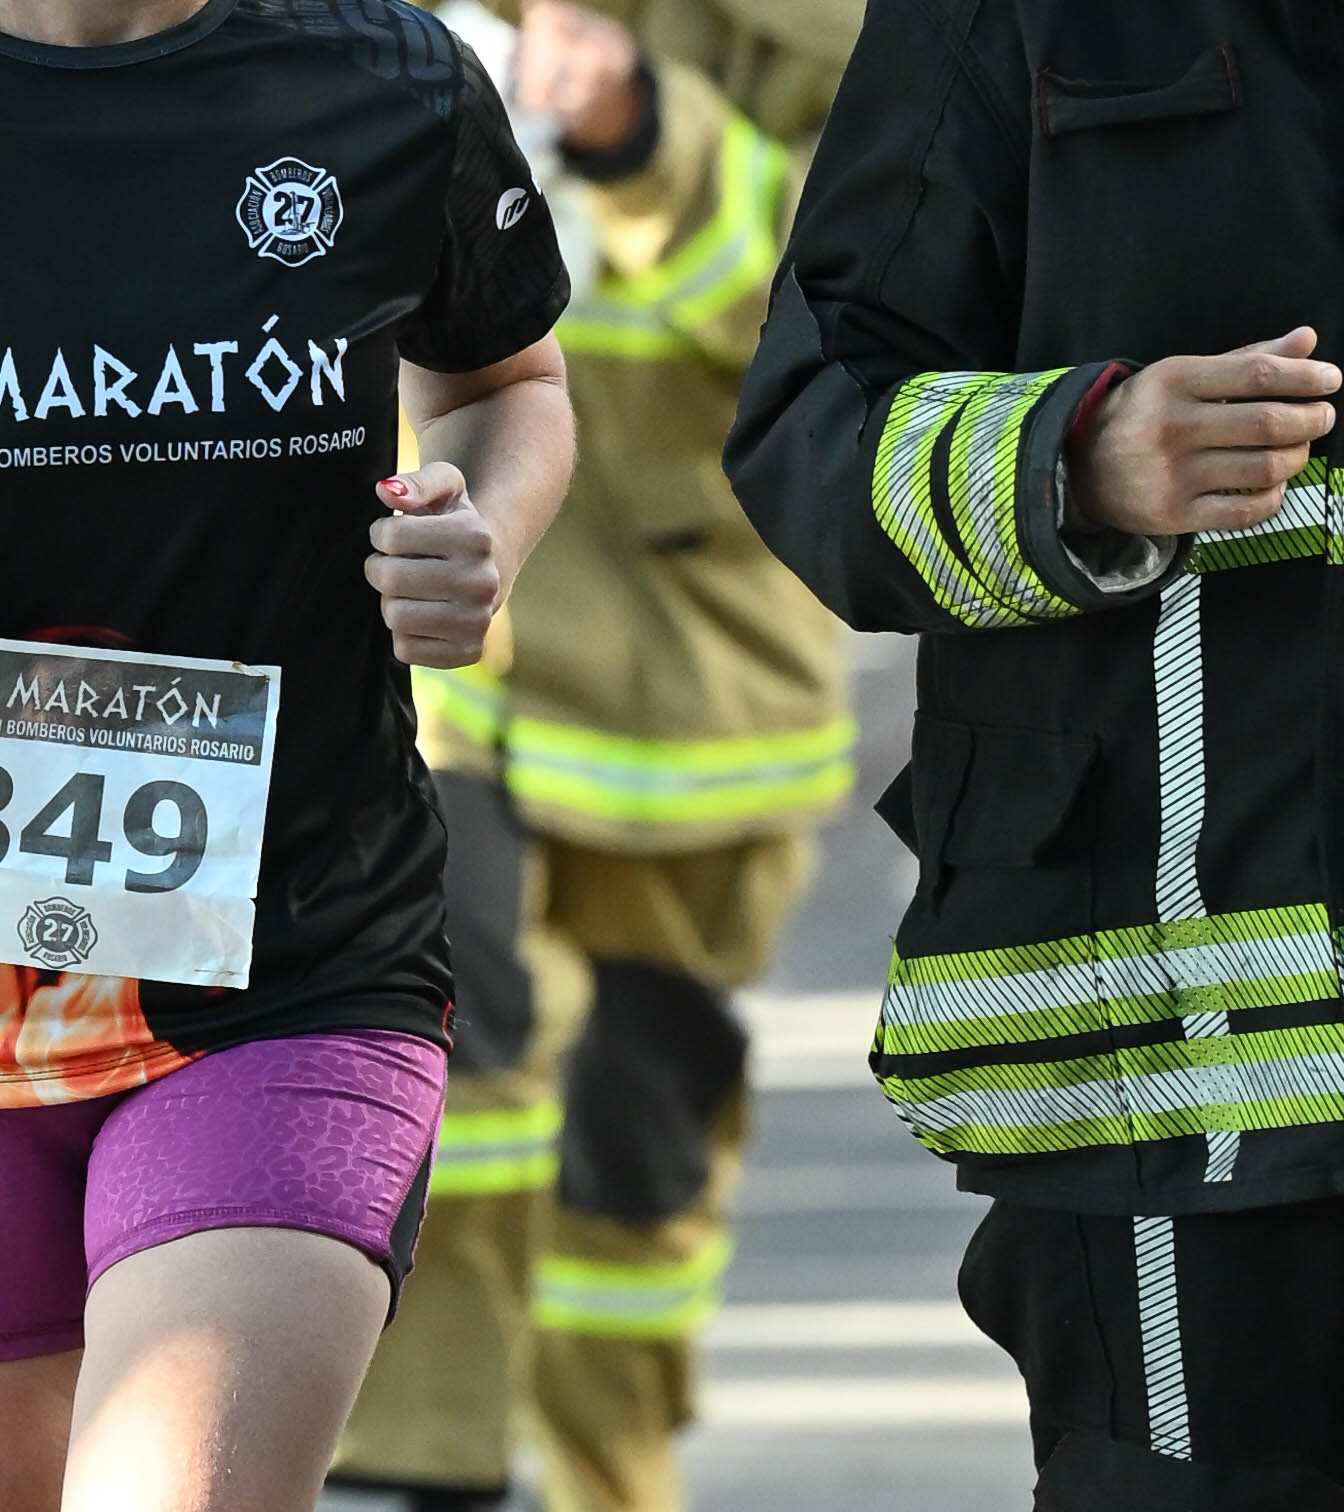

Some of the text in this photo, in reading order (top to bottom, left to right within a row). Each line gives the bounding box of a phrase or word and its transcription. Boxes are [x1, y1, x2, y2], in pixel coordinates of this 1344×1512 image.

[273, 191, 315, 227] 27
[119, 438, 283, 463] VOLUNTARIOS
[289, 426, 366, 457] ROSARIO
[6, 672, 222, 730] MARATÓN
[6, 719, 86, 743] BOMBEROS
[89, 728, 187, 754] VOLUNTARIOS
[190, 738, 255, 761] ROSARIO
[42, 918, 74, 943] 27
